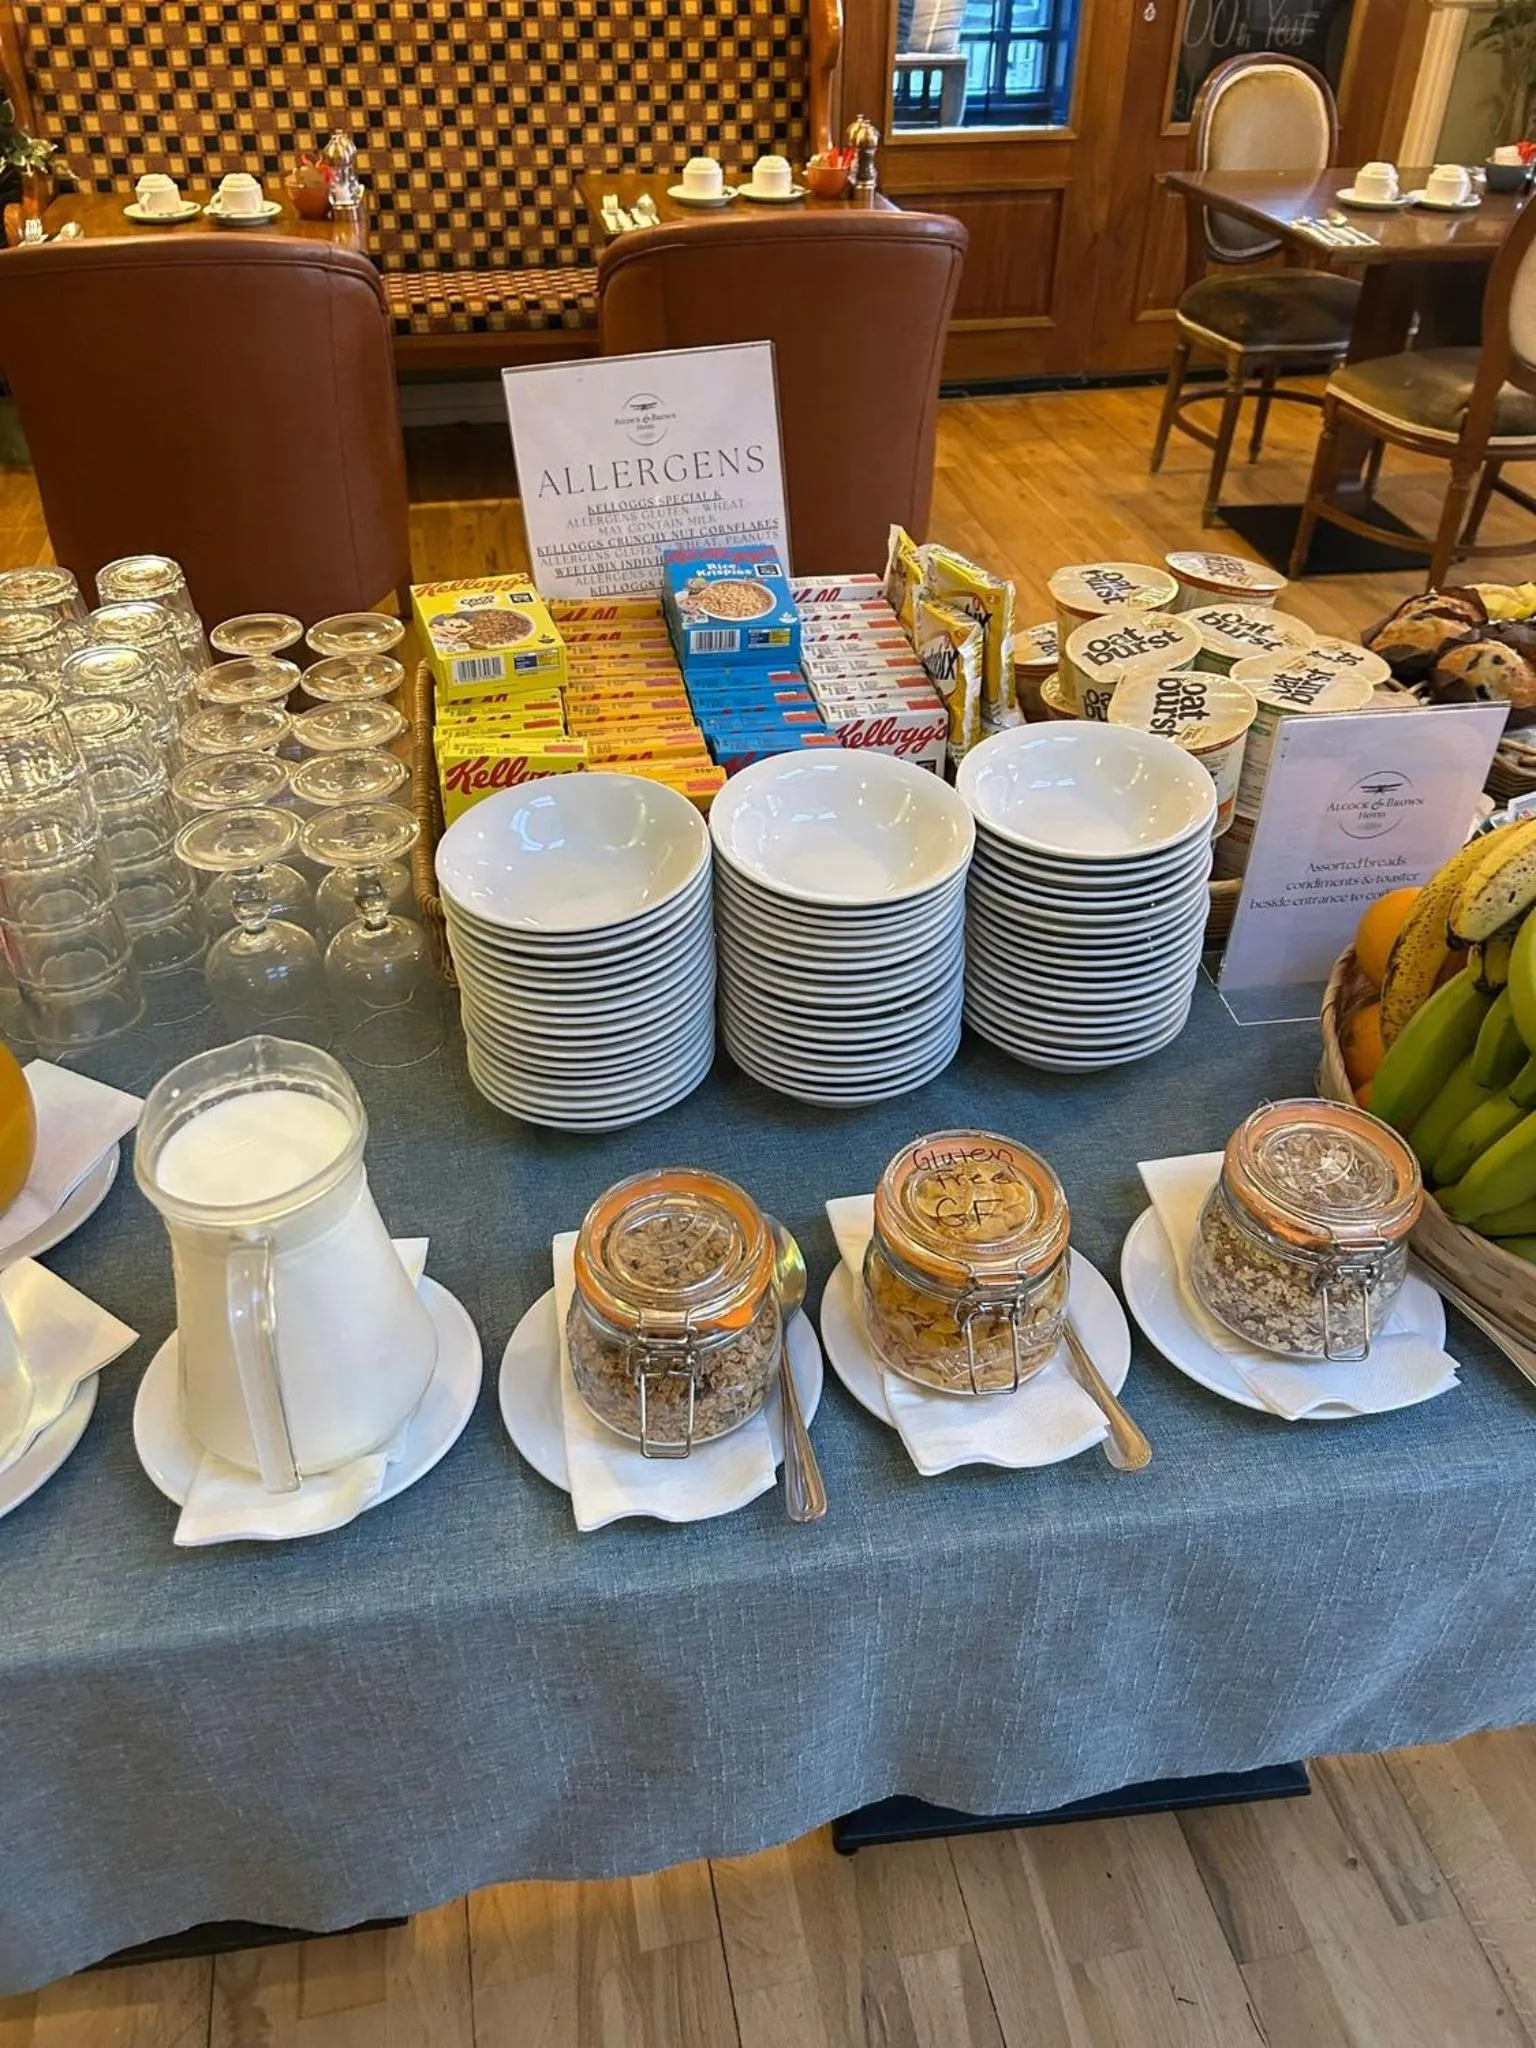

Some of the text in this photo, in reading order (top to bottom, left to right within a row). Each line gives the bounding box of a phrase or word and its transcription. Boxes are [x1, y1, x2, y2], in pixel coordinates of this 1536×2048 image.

[537, 444, 766, 498] ALLERGENS
[567, 499, 745, 529] ALLERGENS GLUTEN WHEAT
[587, 498, 656, 516] KELLOGGS
[659, 491, 708, 508] SPECIAL
[536, 517, 780, 557] KELLOGGS CRUNCHY NUT CORNFLAKES
[598, 514, 717, 536] MAY CONTAIN MILK
[540, 552, 611, 567] ALLERGENS
[555, 561, 617, 579] WEETABIX
[414, 572, 532, 598] Kellogg's
[590, 580, 657, 597] KELLOGGS
[1197, 610, 1285, 652] burst
[1219, 606, 1276, 634] oat
[1082, 628, 1185, 667] burst
[1086, 626, 1145, 652] oat
[1278, 668, 1337, 706] burst
[1148, 677, 1184, 738] burst
[1178, 682, 1211, 721] oat
[835, 716, 948, 756] Kellogg's
[1370, 799, 1386, 811] &
[1307, 853, 1408, 873] Assorted breads
[1285, 872, 1420, 891] condiments & toaster
[1249, 894, 1291, 909] beside
[1291, 891, 1349, 906] entrance
[1350, 890, 1366, 902] to
[912, 1147, 1015, 1172] Gluten
[936, 1168, 1024, 1190] Free!
[928, 1195, 1004, 1228] GF
